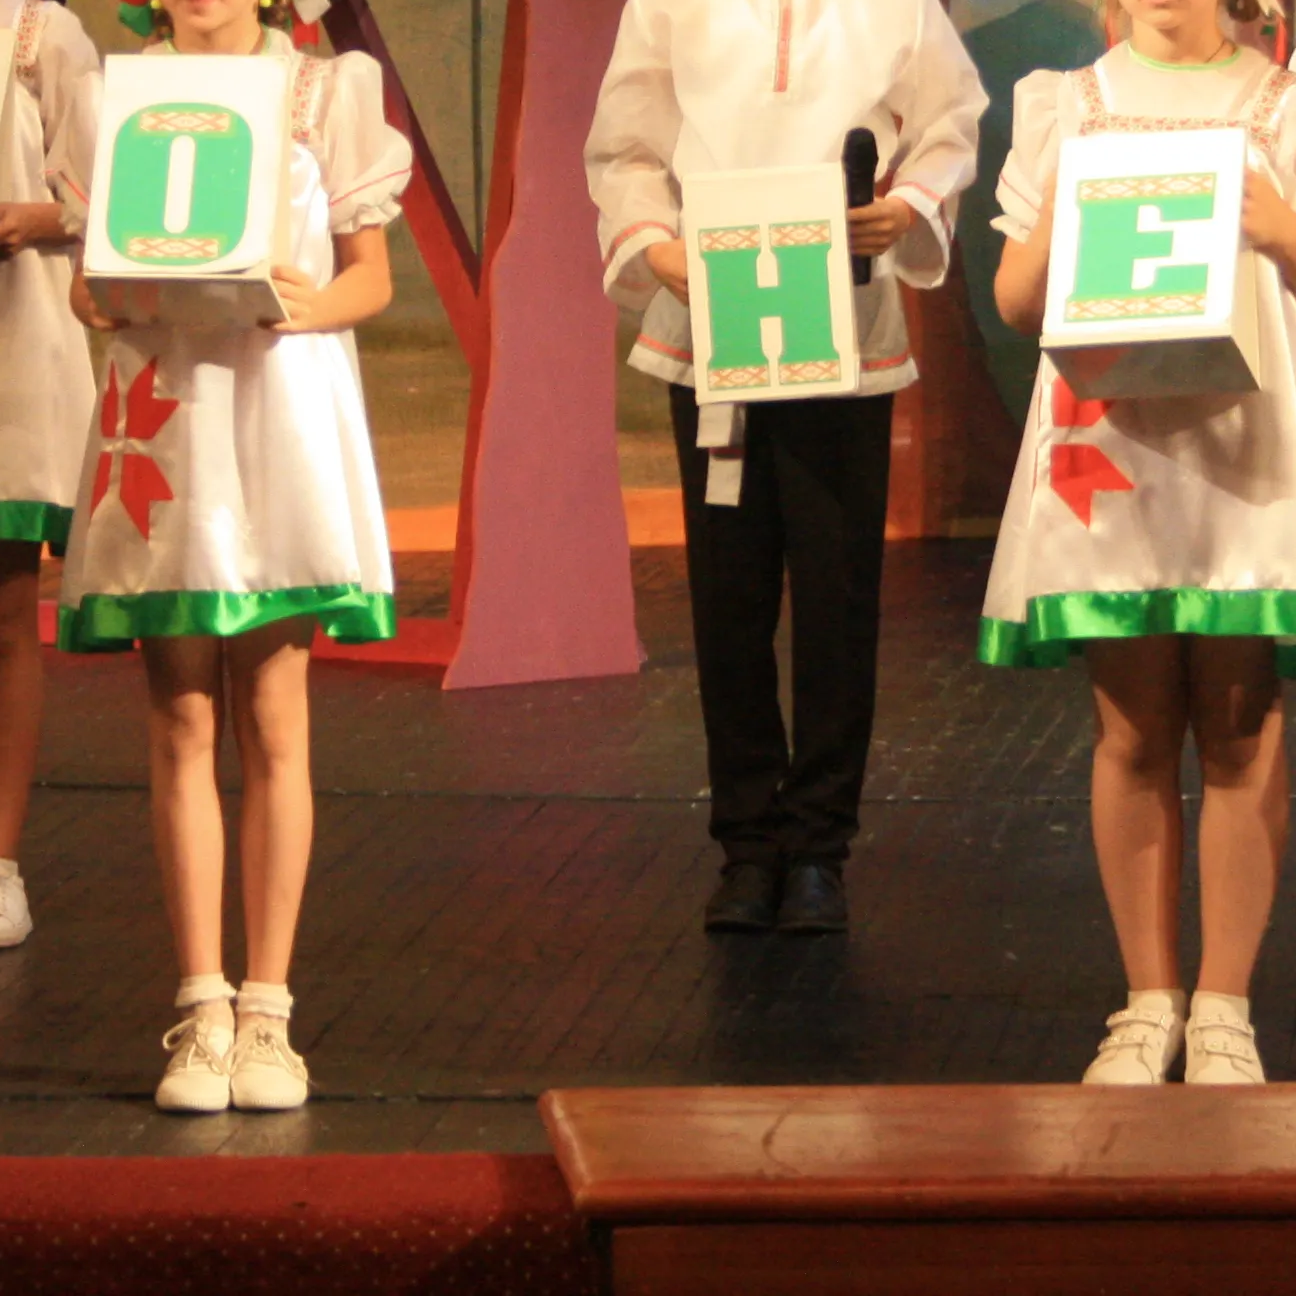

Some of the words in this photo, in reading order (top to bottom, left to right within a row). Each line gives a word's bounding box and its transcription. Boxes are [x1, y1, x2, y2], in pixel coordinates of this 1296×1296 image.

[108, 103, 253, 267] О
[1065, 173, 1217, 320] Е
[698, 220, 843, 391] Н
